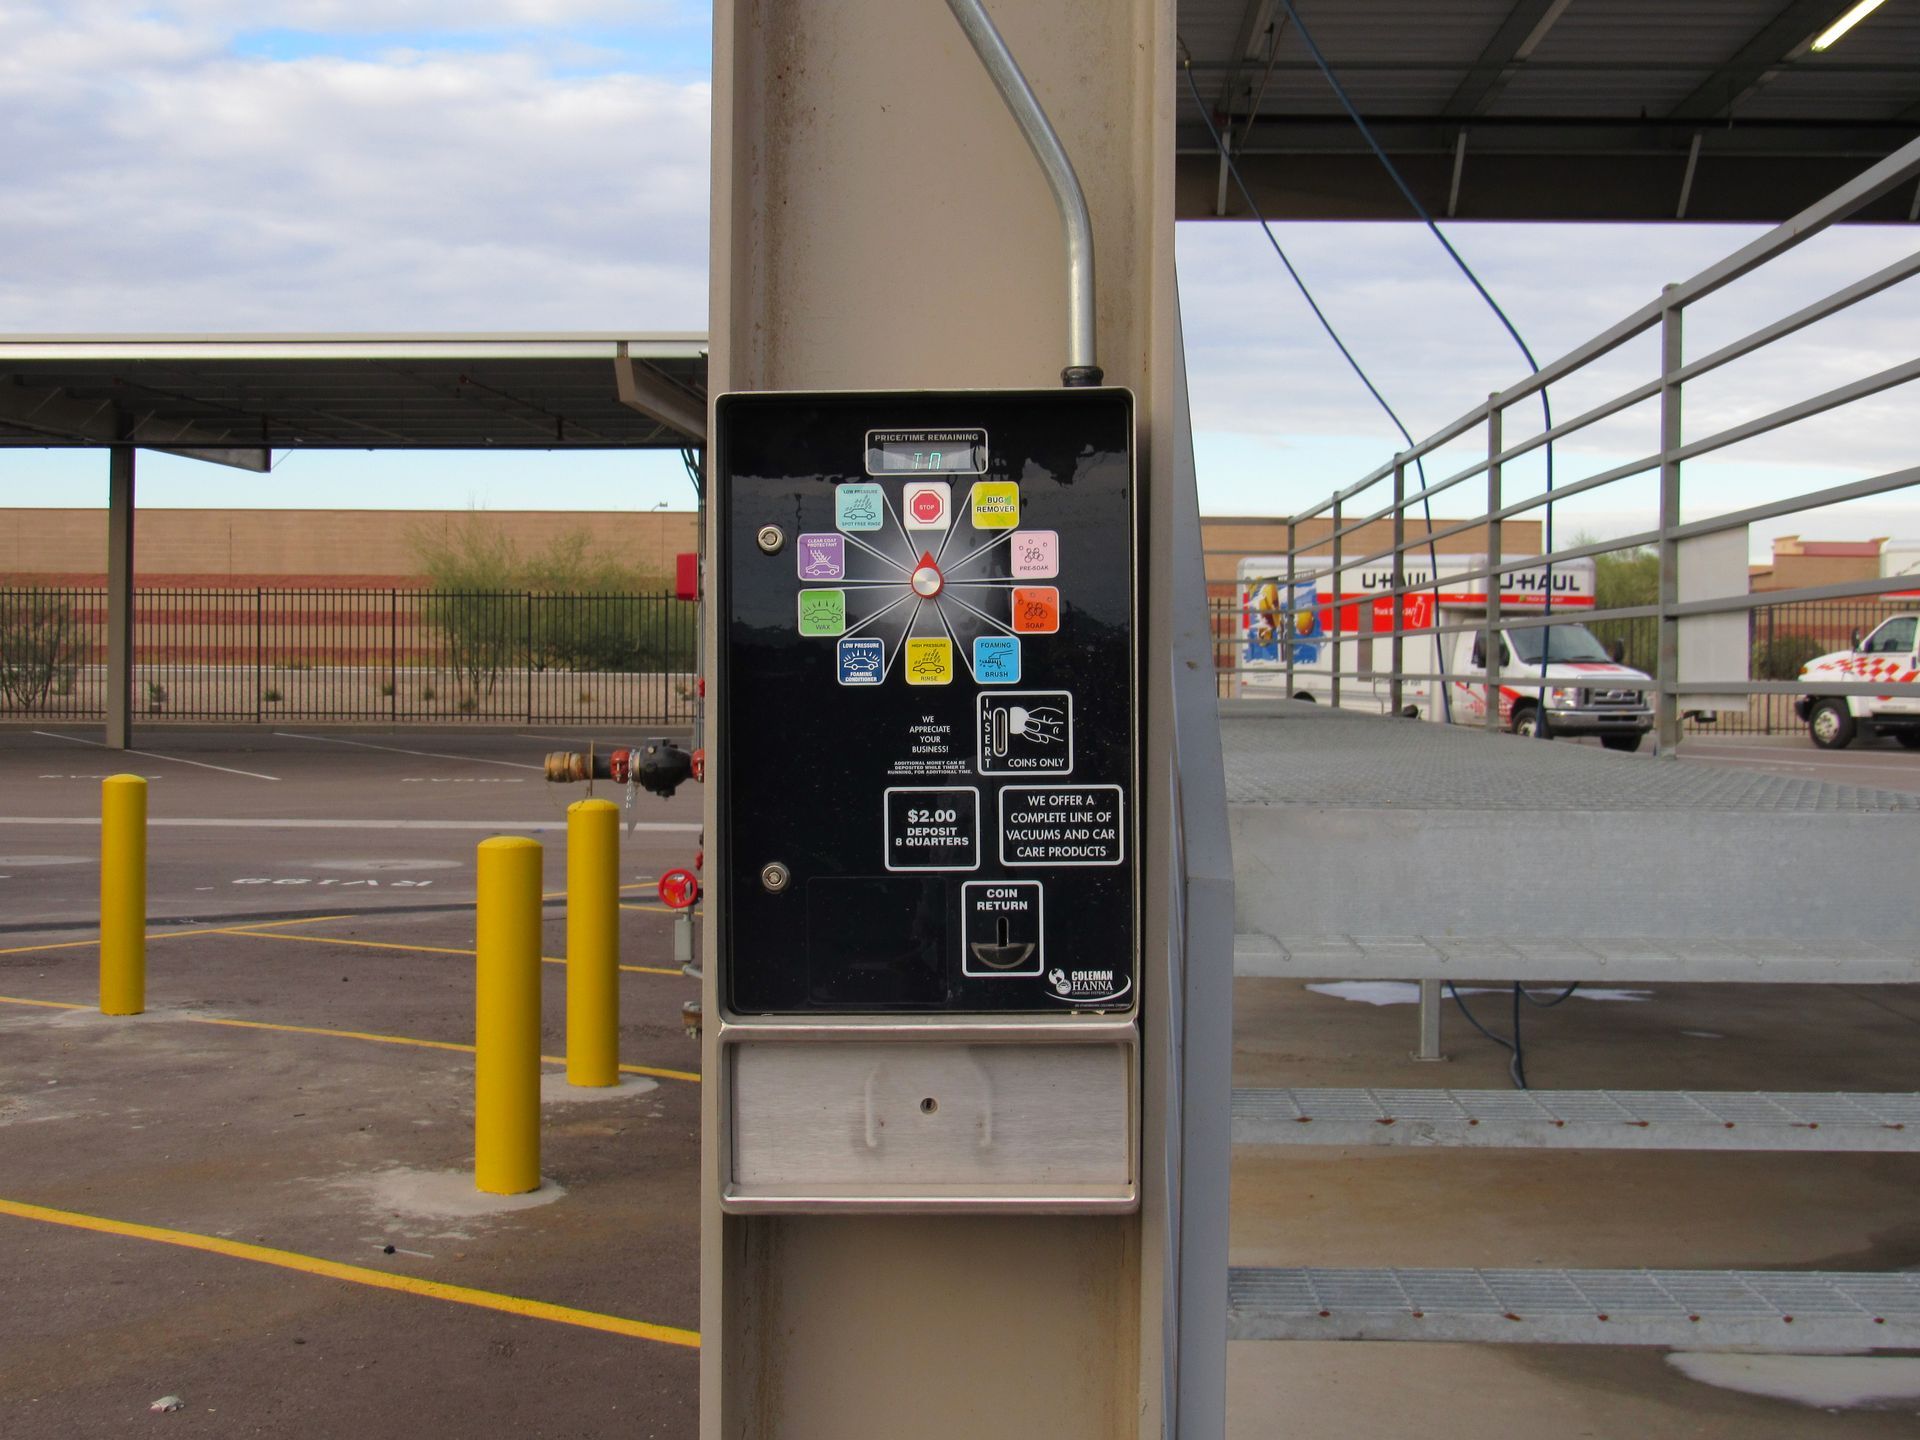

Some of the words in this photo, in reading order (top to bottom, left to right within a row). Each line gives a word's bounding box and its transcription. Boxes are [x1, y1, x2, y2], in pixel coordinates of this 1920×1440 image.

[874, 434, 925, 442] PRICE/TIME
[927, 433, 979, 441] REMAINING
[922, 715, 935, 723] WE
[909, 725, 951, 733] APPRECIATE
[983, 698, 992, 769] INSERT
[920, 735, 941, 743] YOUR
[911, 745, 949, 753] BUSINESS!
[1008, 758, 1037, 767] COINS
[1039, 758, 1065, 767] ONLY
[1027, 795, 1046, 806] WE
[1048, 795, 1083, 806] OFFER
[1085, 794, 1095, 806] A
[907, 808, 957, 824] $2.00
[1010, 812, 1067, 824] COMPLETE
[1069, 812, 1093, 823] LINE
[1096, 812, 1112, 822] OF
[907, 827, 958, 836] DEPOSIT
[1006, 829, 1061, 840] VACUUMS
[1063, 829, 1090, 840] AND
[1092, 828, 1116, 840] CAR
[895, 837, 903, 846] 8
[905, 837, 969, 846] QUARTERS
[1016, 846, 1045, 857] CARE
[1048, 846, 1107, 857] PRODUCTS
[986, 889, 1018, 898] COIN
[976, 901, 1028, 911] RETURN
[1071, 970, 1113, 981] COLEMAN
[1072, 980, 1114, 991] HANNA
